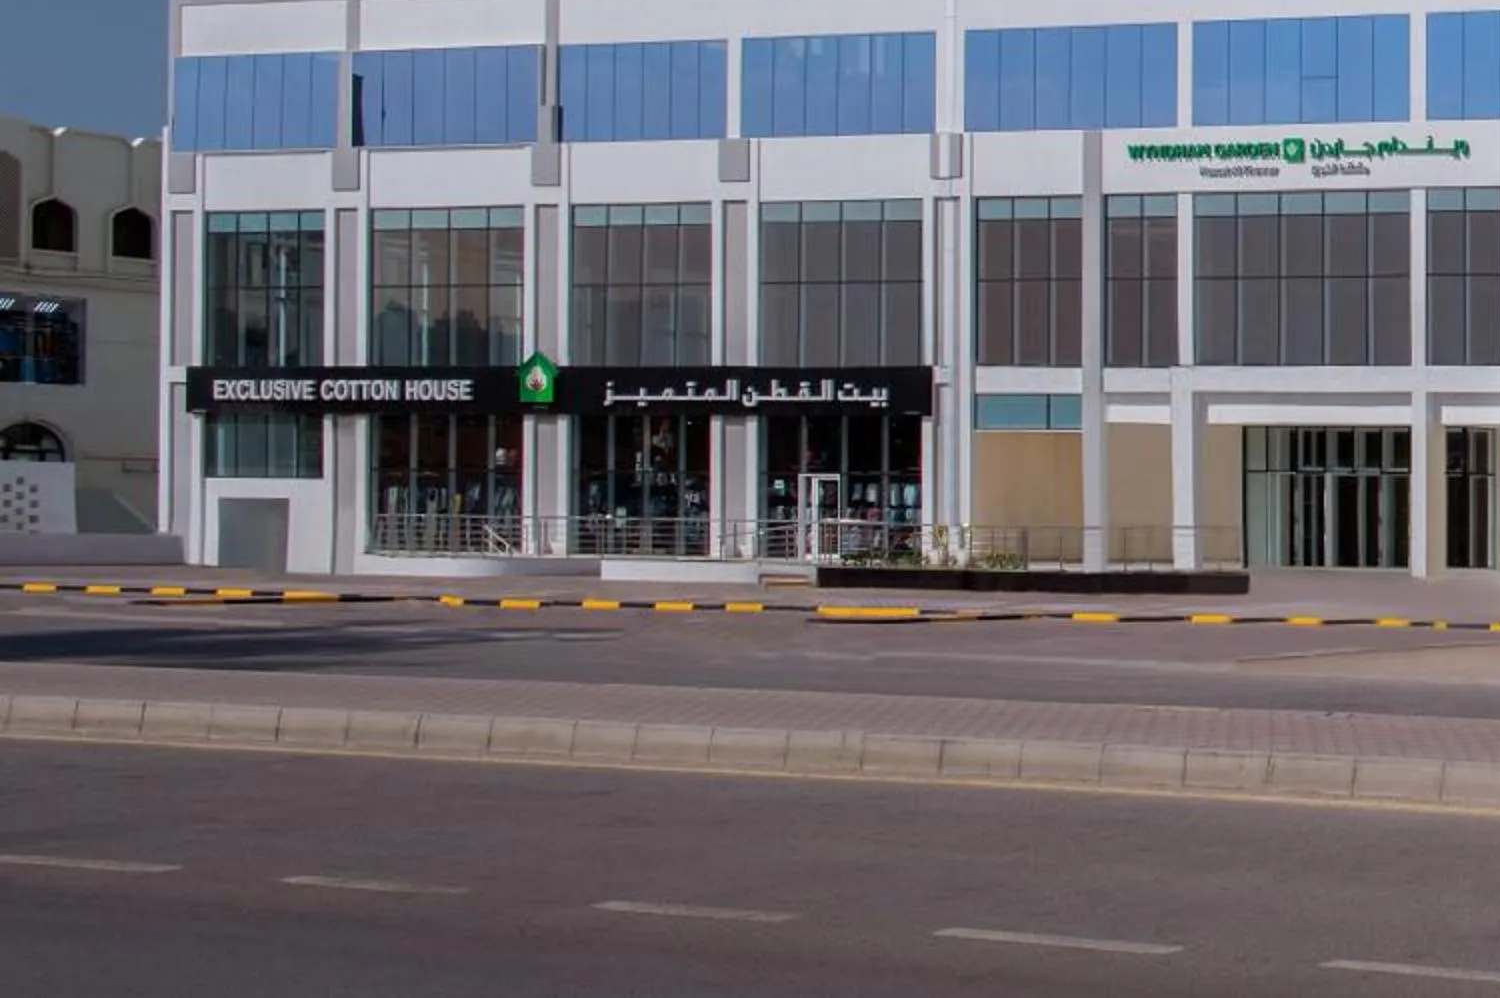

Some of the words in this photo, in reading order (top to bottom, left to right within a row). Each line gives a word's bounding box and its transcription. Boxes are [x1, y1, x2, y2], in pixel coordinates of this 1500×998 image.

[213, 379, 316, 401] EXCLUSIVE
[320, 379, 399, 401] COTTON
[405, 379, 474, 401] HOUSE
[603, 379, 740, 407] المتميز
[742, 379, 835, 408] القطن
[837, 383, 888, 408] بيت
